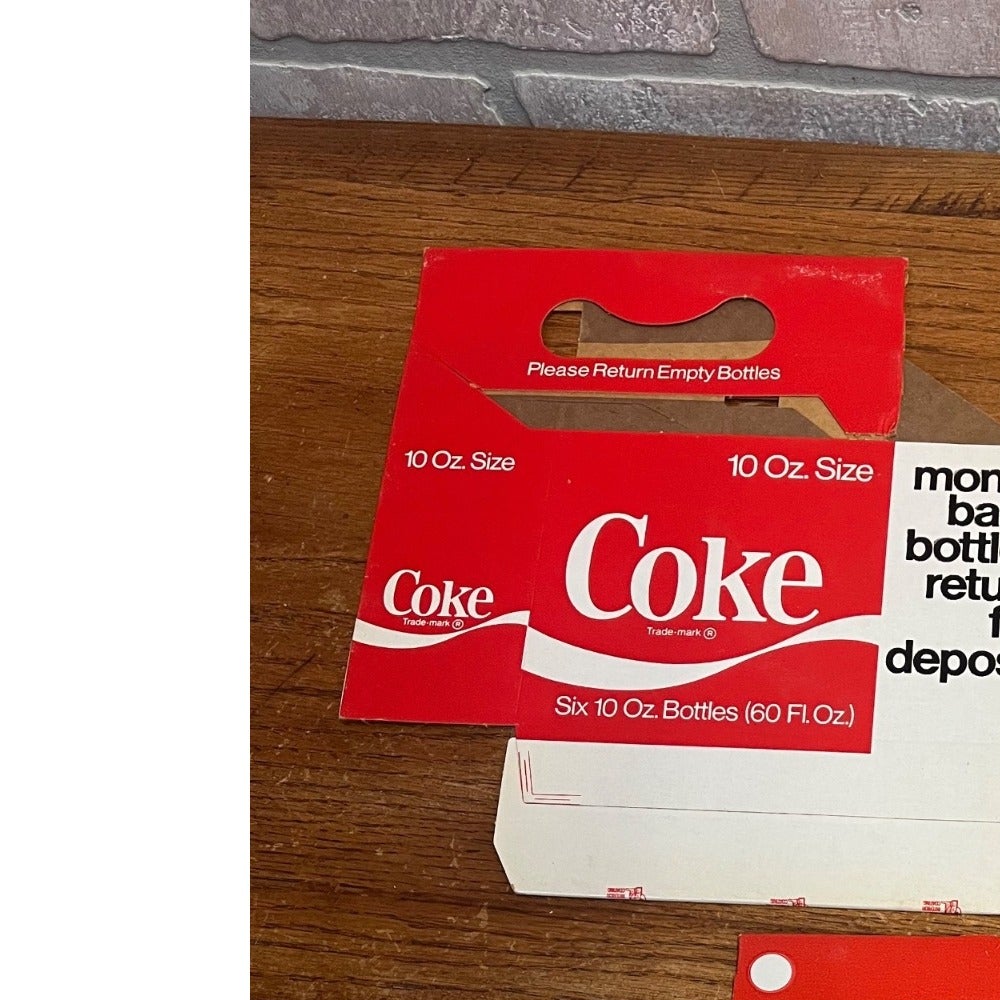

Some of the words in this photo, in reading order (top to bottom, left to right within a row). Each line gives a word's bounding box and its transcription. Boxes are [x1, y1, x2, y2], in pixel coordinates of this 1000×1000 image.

[527, 362, 589, 377] Please
[593, 363, 654, 379] Return
[657, 365, 715, 382] Empty
[717, 366, 781, 380] Bottles
[405, 450, 427, 468] 10
[432, 451, 465, 470] Oz.
[470, 452, 515, 471] Size
[727, 454, 758, 478] 10
[764, 454, 809, 480] Oz.
[815, 457, 874, 482] Size
[565, 512, 823, 623] Coke
[383, 569, 493, 619] Coke
[402, 618, 450, 627] Trade-mark
[647, 627, 701, 637] Trade-mark
[555, 696, 588, 716] Six
[595, 699, 618, 717] 10
[623, 699, 657, 719] Oz.
[663, 700, 738, 721] Bottles
[745, 701, 781, 723] (60
